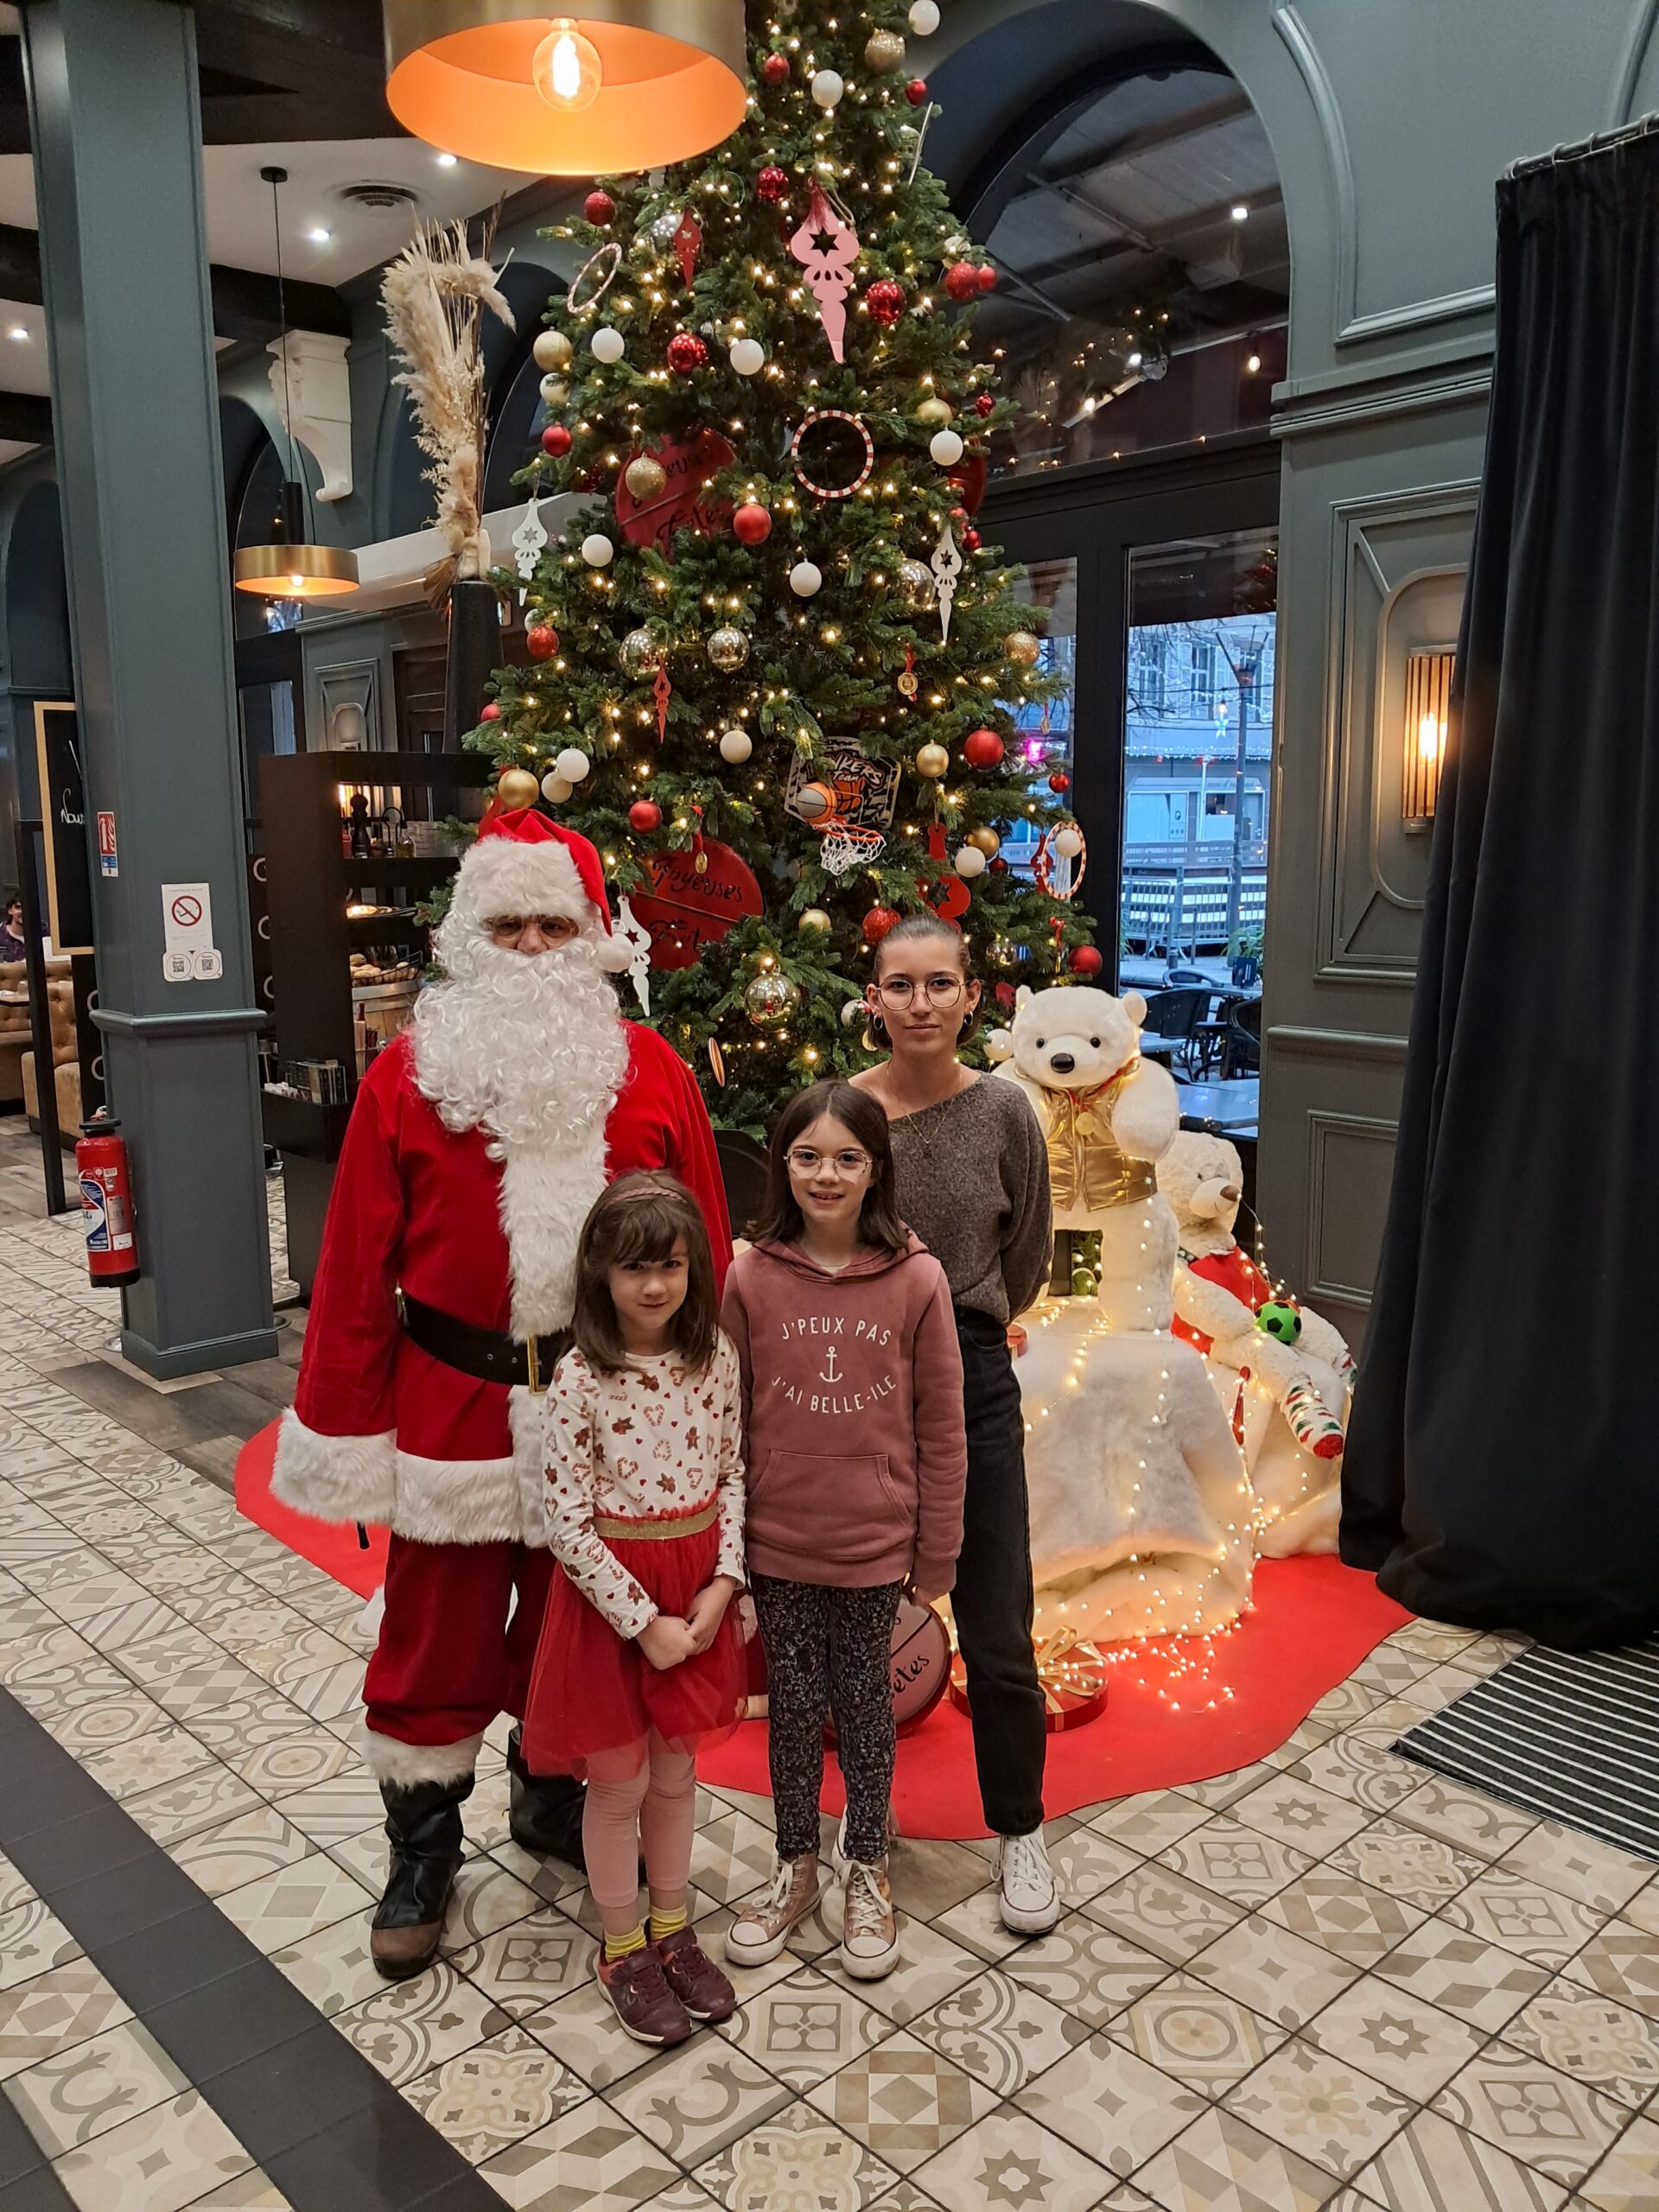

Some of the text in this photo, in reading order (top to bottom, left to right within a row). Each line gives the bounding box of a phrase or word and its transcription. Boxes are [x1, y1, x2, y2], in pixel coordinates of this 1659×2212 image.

[832, 770, 860, 783] Team
[651, 856, 743, 902] Joyeuses
[782, 1317, 892, 1346] J'PEUX PAS
[772, 1375, 897, 1414] J'AI BELLE-ILE
[892, 1654, 931, 1695] etes
